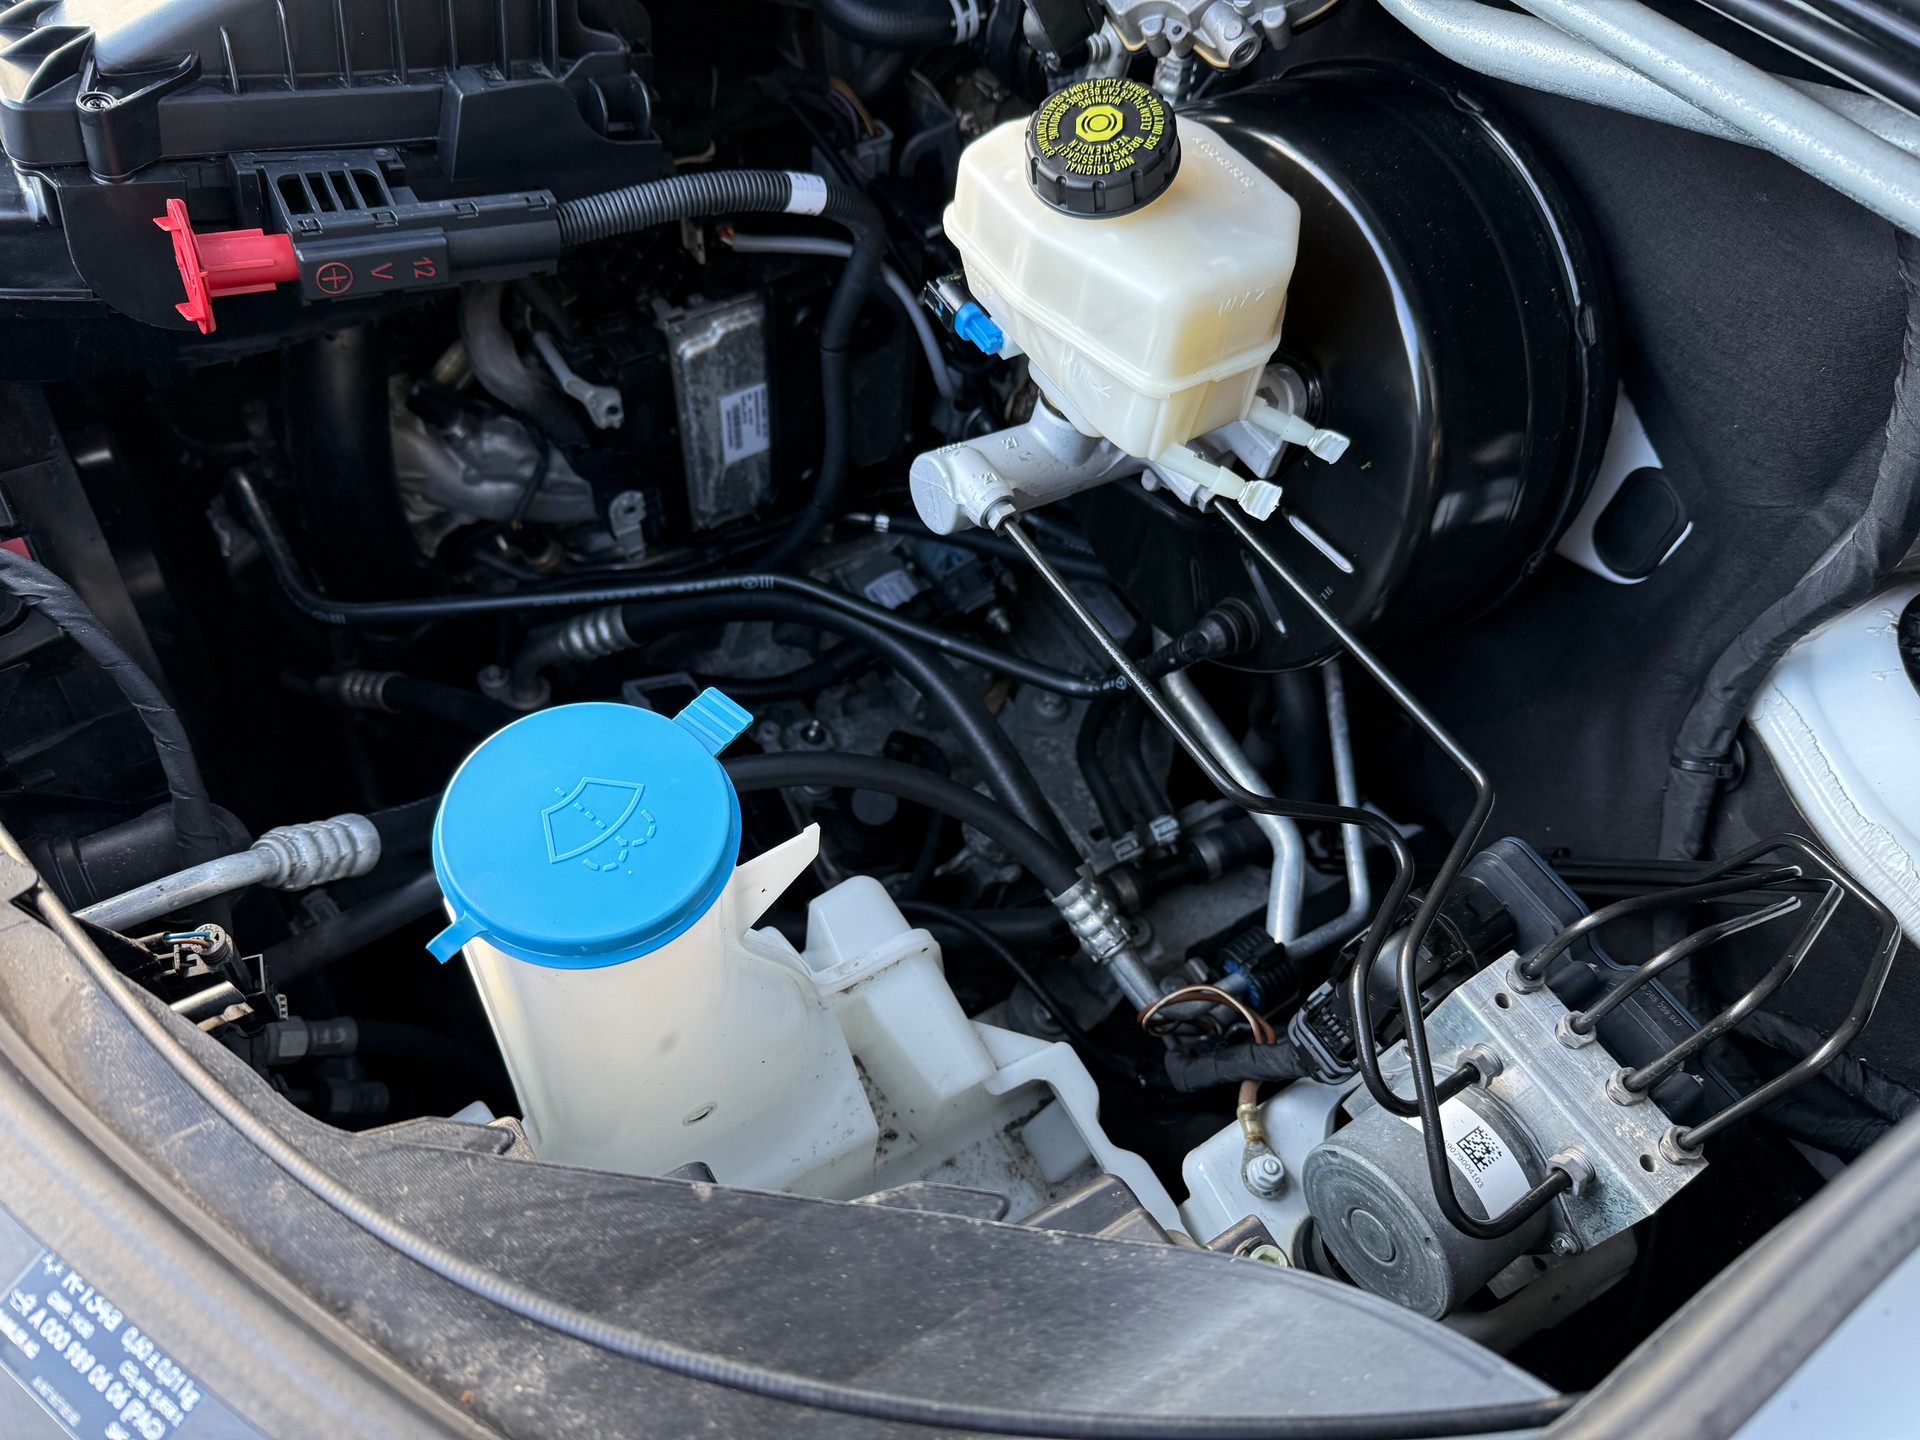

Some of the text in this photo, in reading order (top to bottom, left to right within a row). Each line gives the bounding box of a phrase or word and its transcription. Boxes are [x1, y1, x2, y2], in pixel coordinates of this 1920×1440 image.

[1069, 80, 1094, 95] FROM
[1095, 79, 1122, 88] FLUID
[1122, 81, 1149, 97] BRAKE
[1061, 90, 1069, 98] A
[1078, 95, 1122, 109] WARNING
[1040, 95, 1064, 119] SEALED
[1048, 87, 1152, 140] CLEAN FILLER CAP BEFORE REMOVING
[1152, 116, 1165, 135] ONLY
[1036, 120, 1056, 158] CONTAINER
[1068, 135, 1130, 155] VERWENDEN
[1143, 134, 1161, 150] USE
[1055, 136, 1144, 165] BREMSFLÜSSIGKEIT
[1065, 156, 1135, 175] NUR ORIGINAL
[370, 262, 395, 280] V
[413, 256, 437, 279] 12
